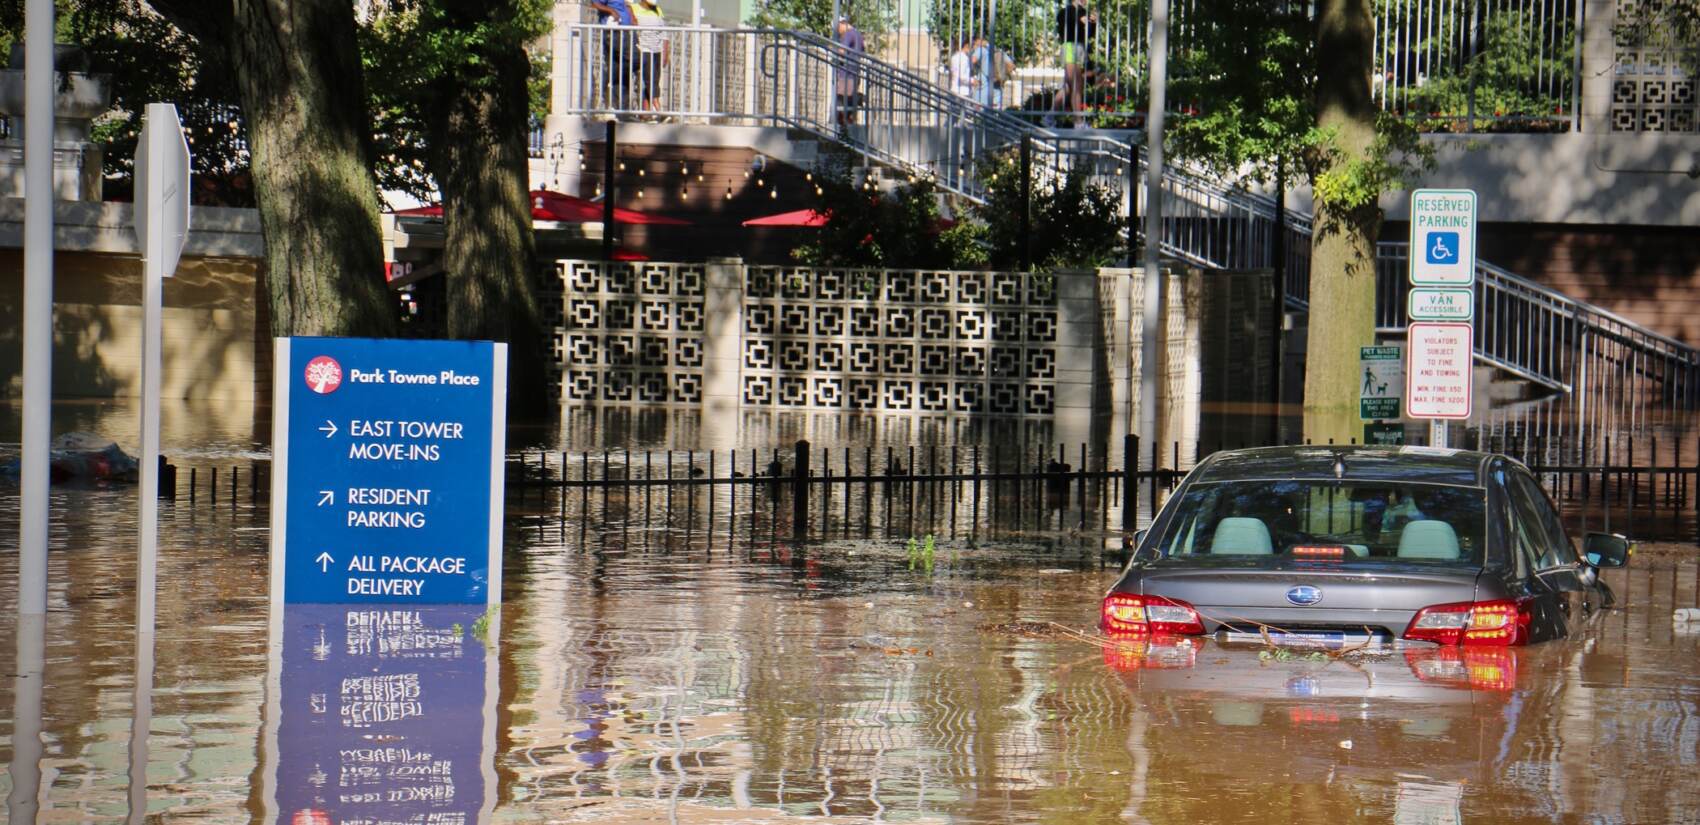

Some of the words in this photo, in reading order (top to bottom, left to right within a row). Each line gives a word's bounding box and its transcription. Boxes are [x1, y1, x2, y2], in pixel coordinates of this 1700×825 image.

[1417, 199, 1471, 211] RESERVED
[1419, 216, 1468, 228] PARKING
[1430, 295, 1453, 304] VAN
[350, 368, 385, 384] Park
[388, 369, 437, 385] Towne
[440, 370, 480, 386] Place
[350, 420, 394, 437] EAST
[398, 421, 464, 439] TOWER
[349, 443, 440, 461] MOVE-INS
[348, 488, 431, 506] RESIDENT
[347, 511, 425, 529] PARKING
[348, 555, 376, 572] ALL
[380, 556, 466, 574] PACKAGE
[347, 578, 425, 596] DELIVERY
